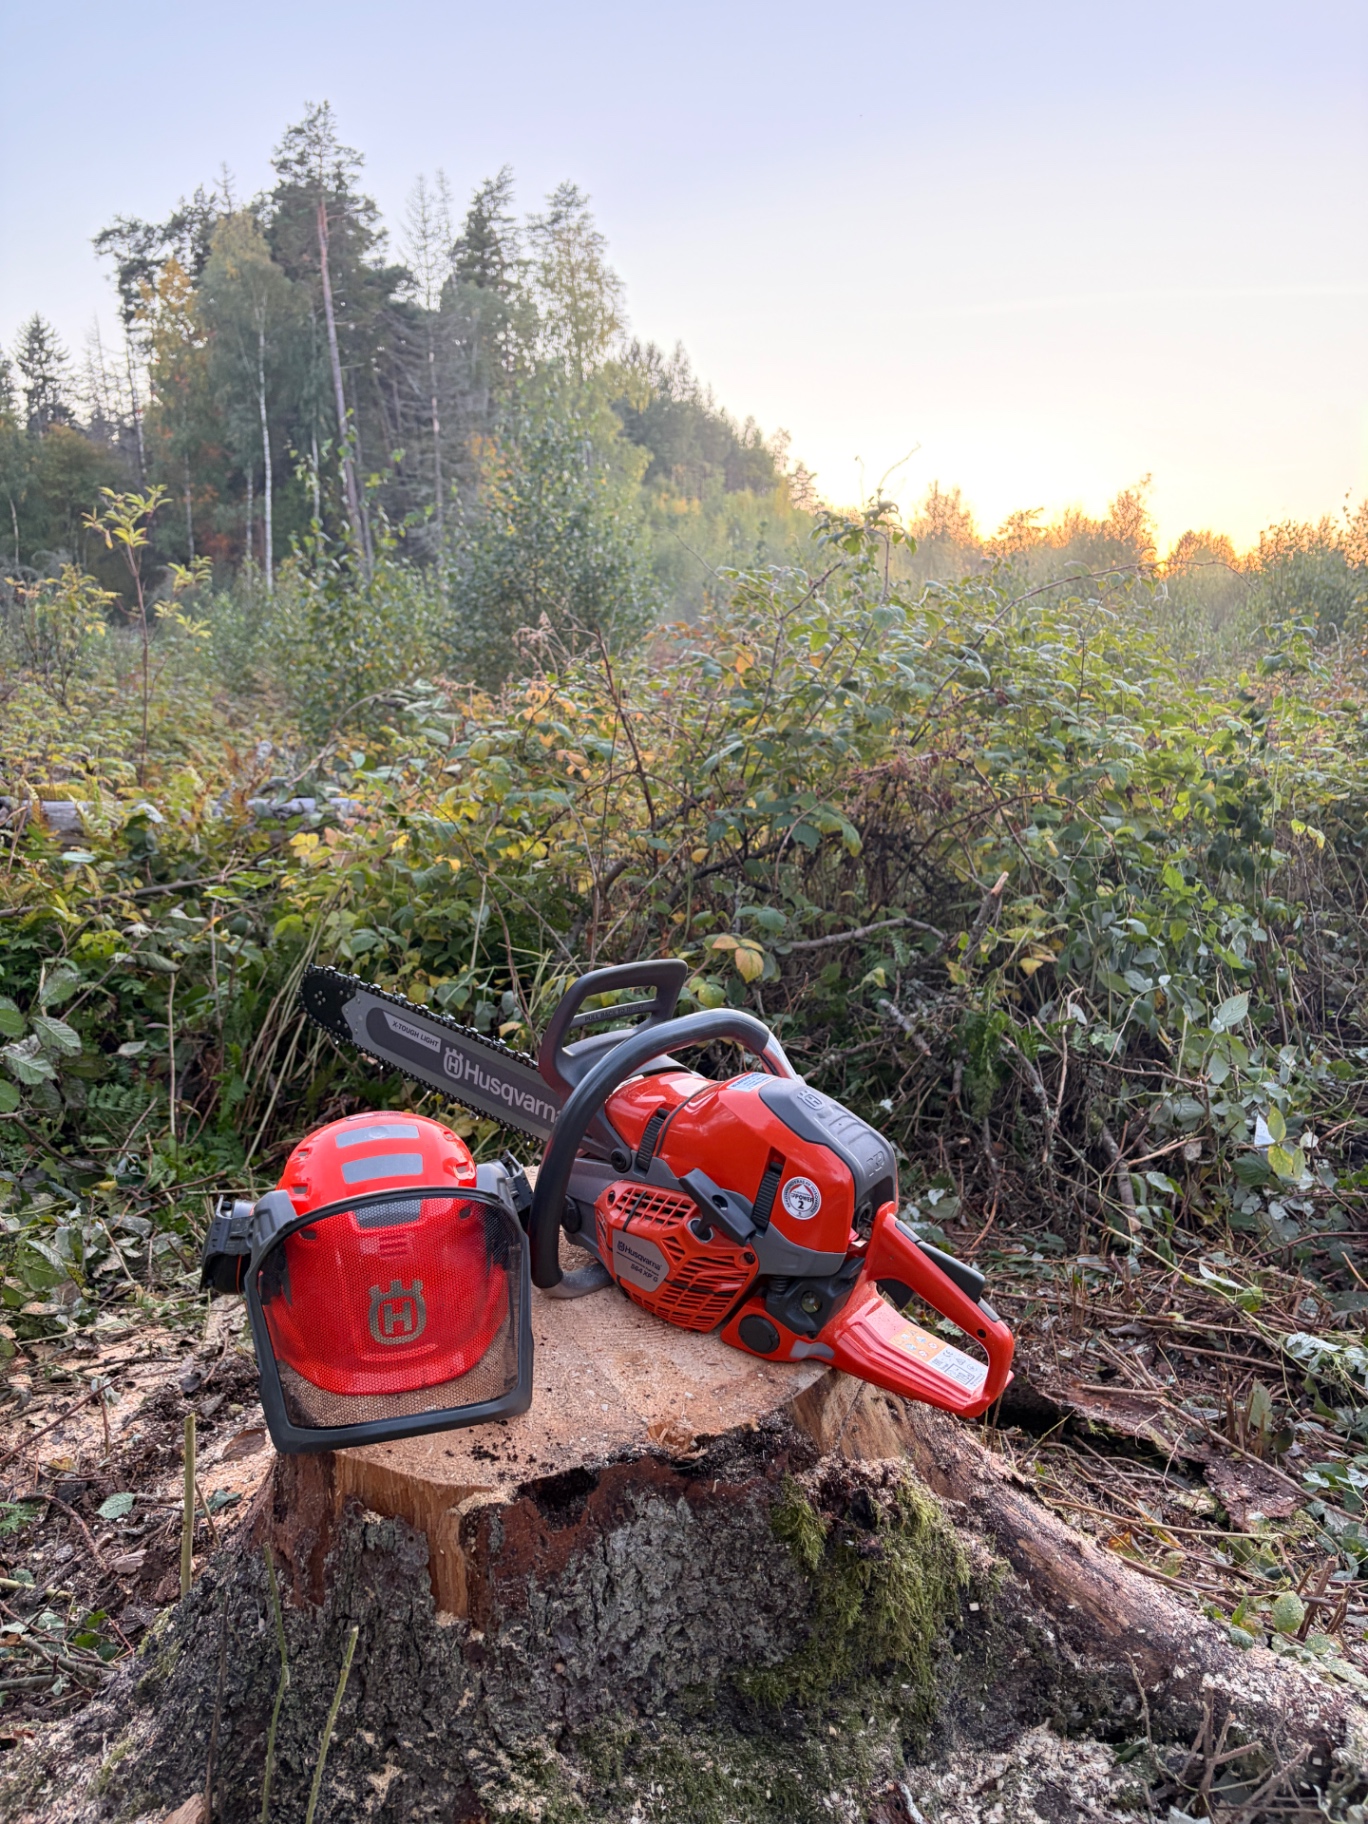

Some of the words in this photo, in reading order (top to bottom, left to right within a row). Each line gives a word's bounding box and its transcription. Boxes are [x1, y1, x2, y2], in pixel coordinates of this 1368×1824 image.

[585, 1014, 599, 1022] PULL
[392, 1020, 419, 1039] X-TOUGH
[420, 1033, 439, 1048] LIGHT
[624, 1245, 661, 1271] Husqvarna
